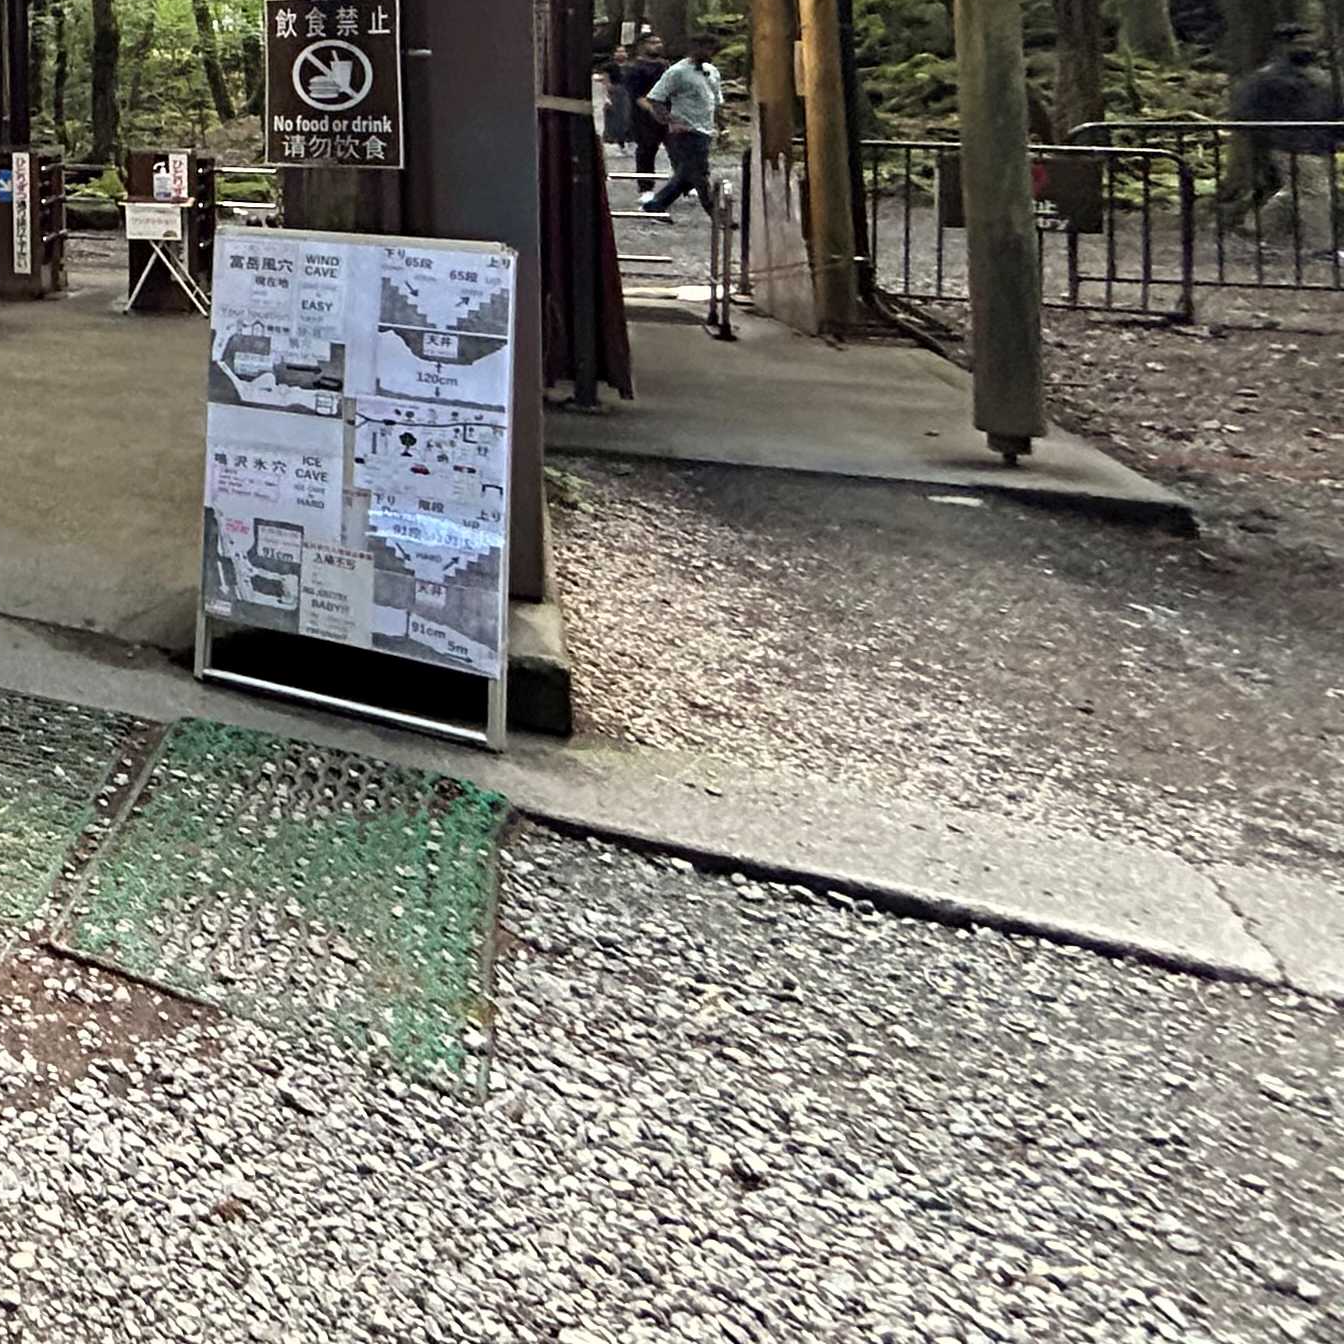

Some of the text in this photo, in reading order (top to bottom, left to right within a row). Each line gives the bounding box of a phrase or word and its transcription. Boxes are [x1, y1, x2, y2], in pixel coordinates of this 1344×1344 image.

[275, 5, 392, 38] 飲食禁止
[274, 114, 393, 133] No food or drink
[282, 135, 387, 161] 请勿饮食
[229, 254, 294, 273] 富岳風穴
[305, 254, 340, 267] WIND
[305, 266, 338, 279] CAVE
[301, 299, 334, 313] EASY
[427, 335, 452, 348] 天井
[416, 372, 459, 387] 120cm
[301, 455, 322, 469] ICE
[294, 468, 328, 483] CAVE
[262, 546, 294, 561] 91cm
[448, 641, 469, 655] 5m
